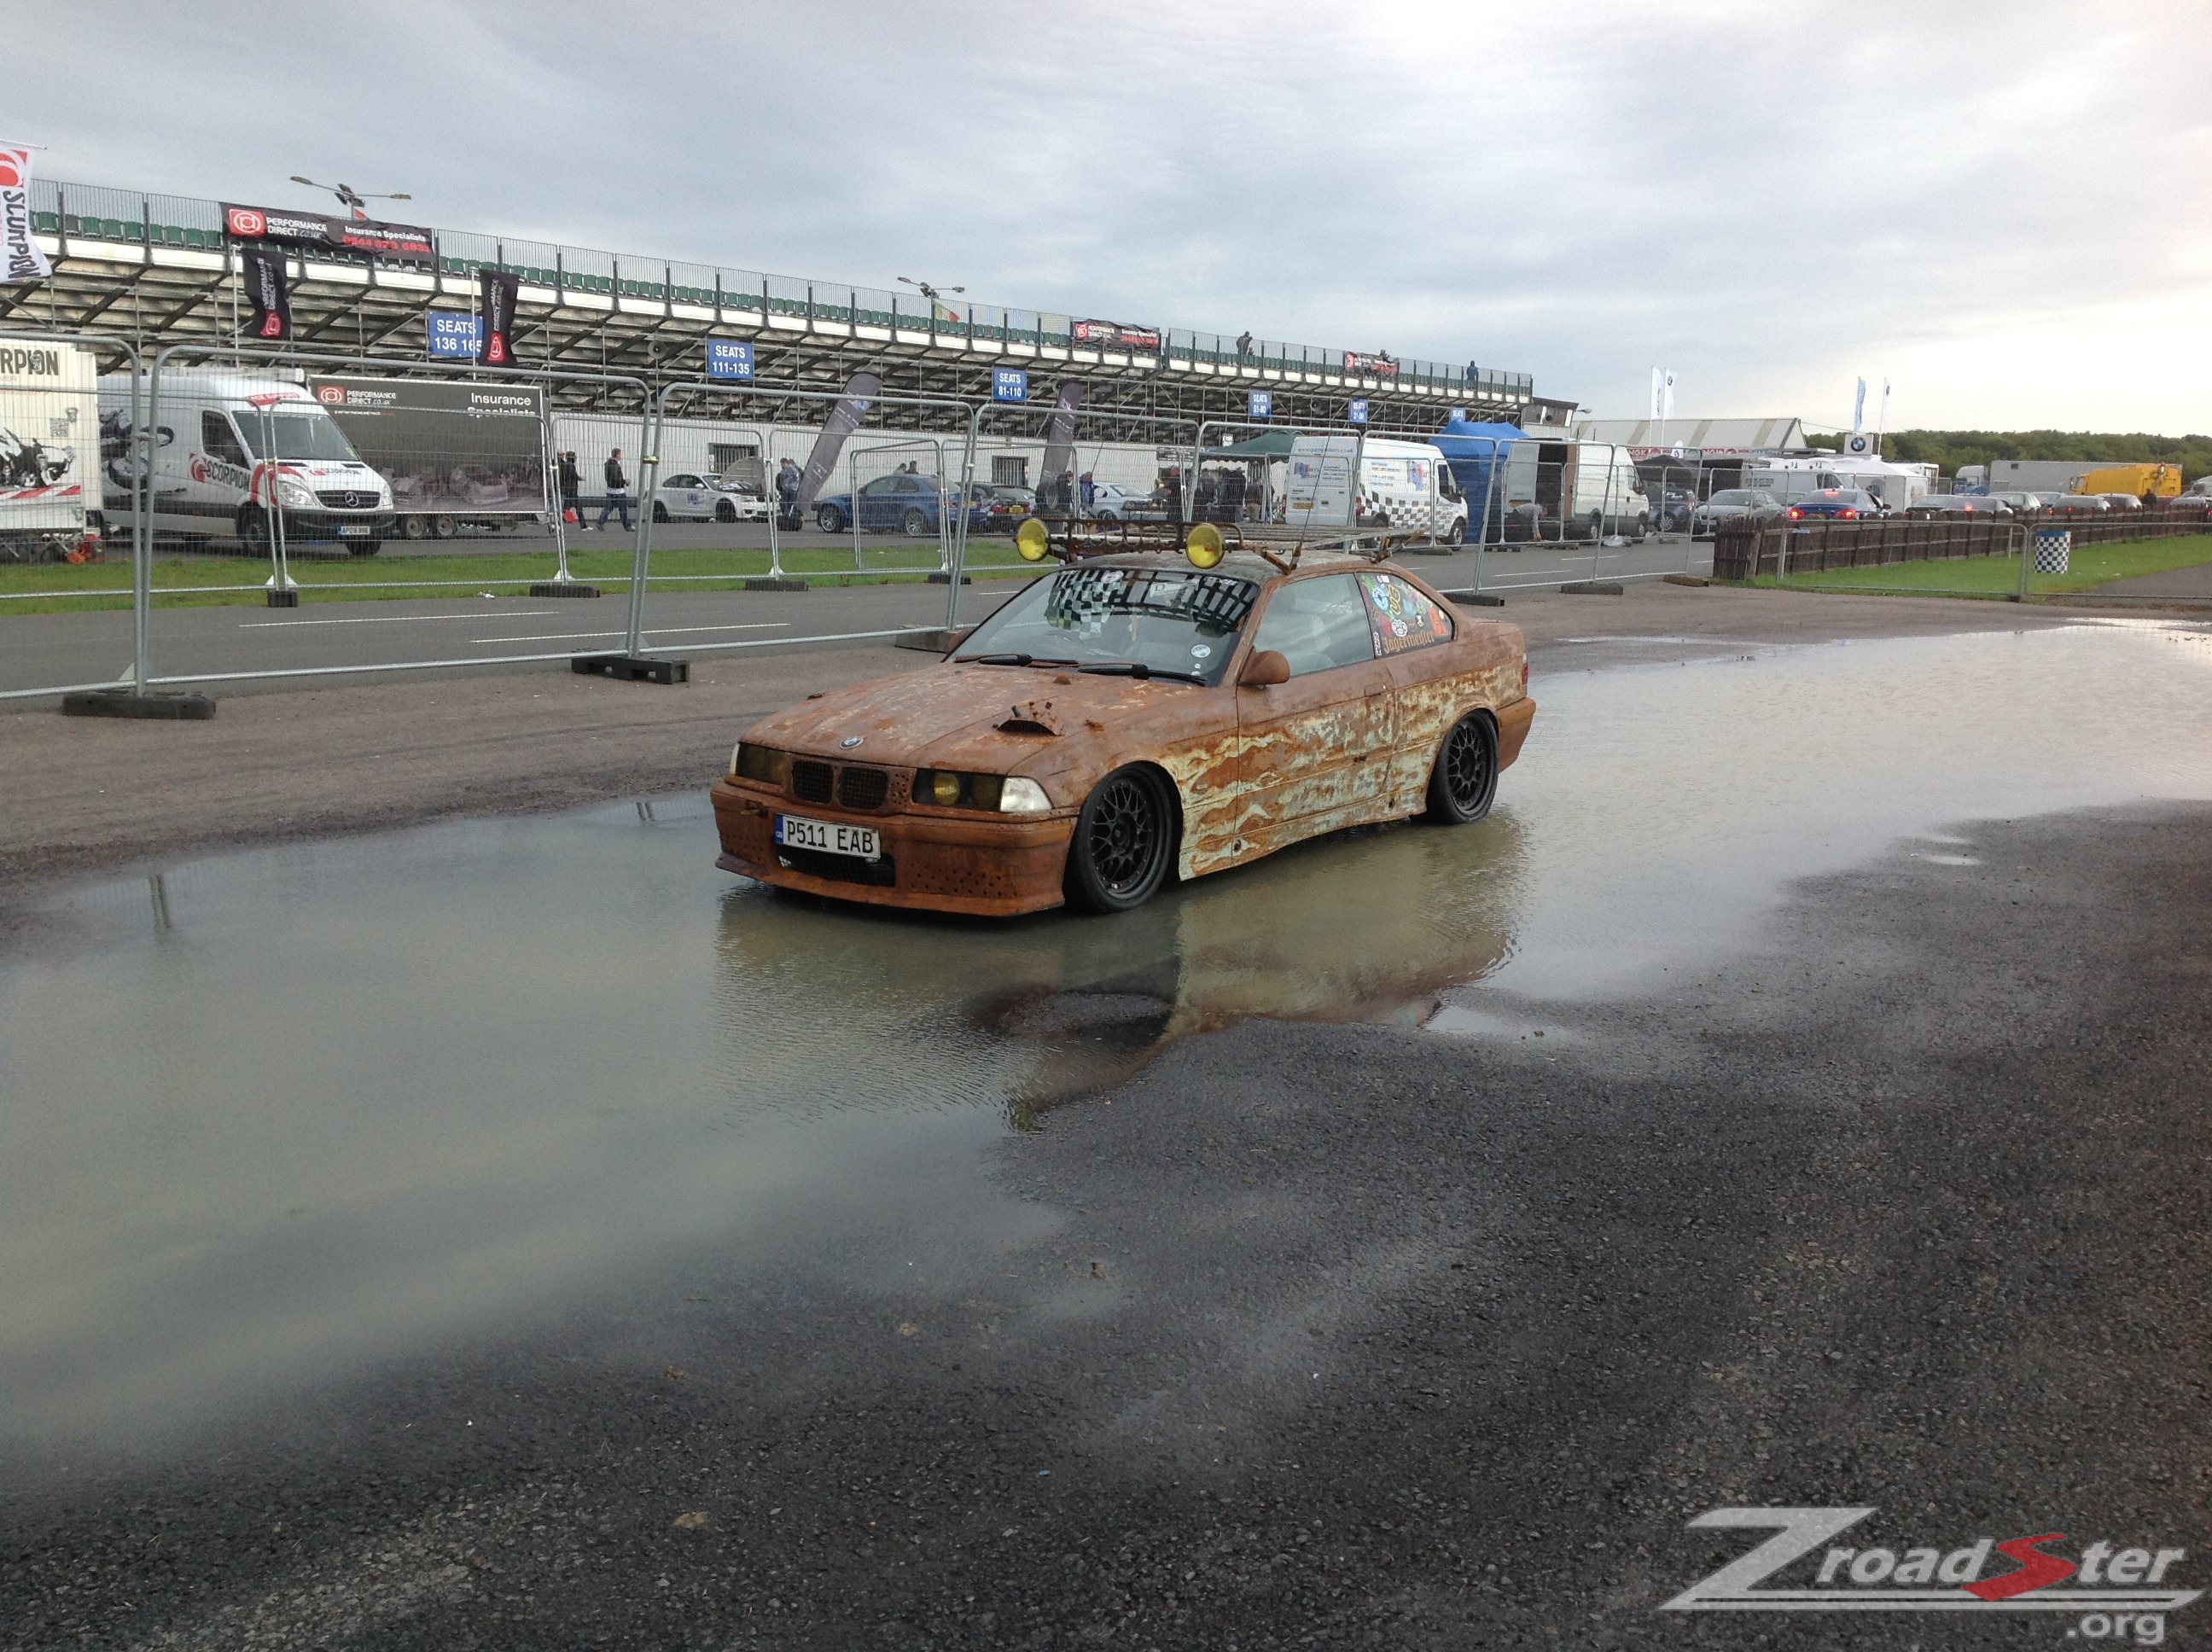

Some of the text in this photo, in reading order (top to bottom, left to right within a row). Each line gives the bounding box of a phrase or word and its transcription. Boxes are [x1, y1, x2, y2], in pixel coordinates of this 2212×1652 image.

[266, 217, 327, 231] PERFORMANCE
[345, 225, 426, 242] Insurance Specialists
[437, 319, 476, 334] SEATS
[435, 336, 482, 352] 136 165
[715, 345, 746, 358] SEATS
[713, 361, 750, 375] 111-135
[999, 372, 1021, 384] SEATS
[346, 391, 397, 399] PERFORMANCE
[998, 386, 1022, 397] 81-110
[471, 393, 532, 405] Insurance
[207, 461, 250, 492] SCORPION
[787, 820, 874, 854] P511 EAB
